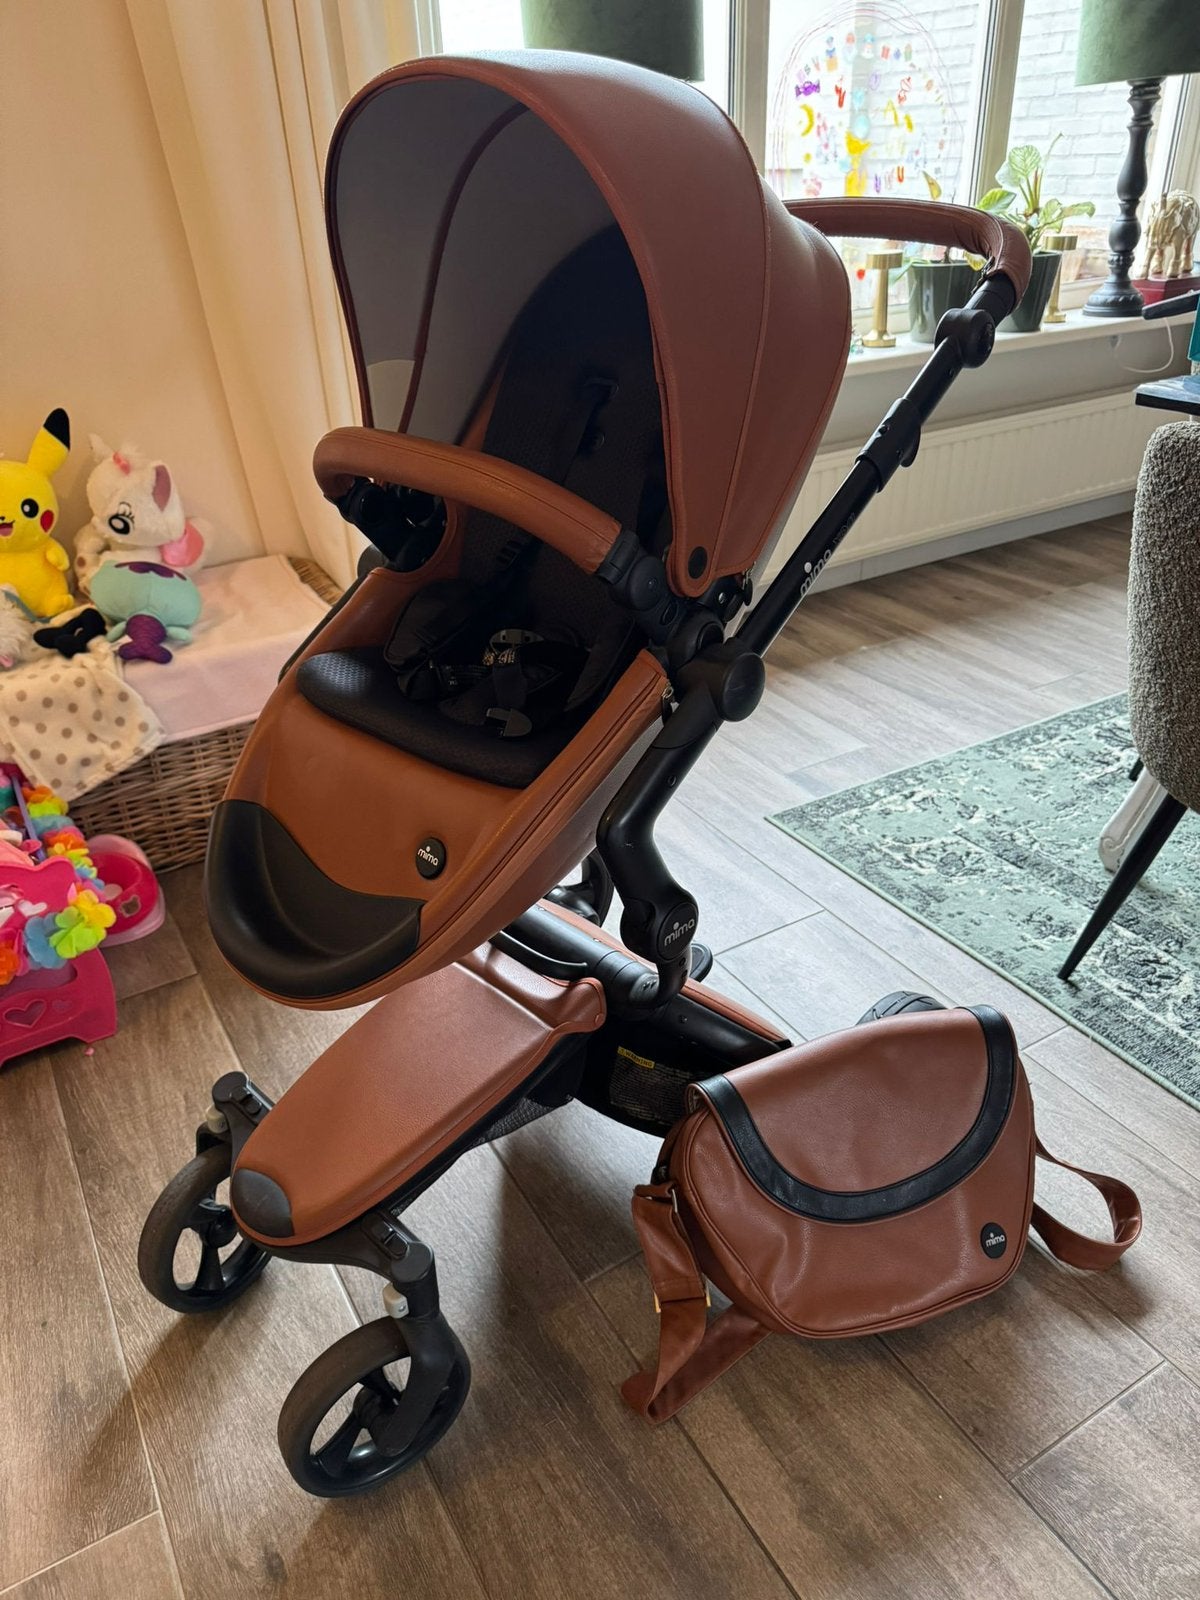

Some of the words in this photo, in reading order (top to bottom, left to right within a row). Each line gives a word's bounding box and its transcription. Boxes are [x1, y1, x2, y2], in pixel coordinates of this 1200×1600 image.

[417, 845, 439, 866] mima
[664, 918, 695, 947] mima
[625, 1050, 653, 1068] WARNING
[985, 1232, 1005, 1248] mima
